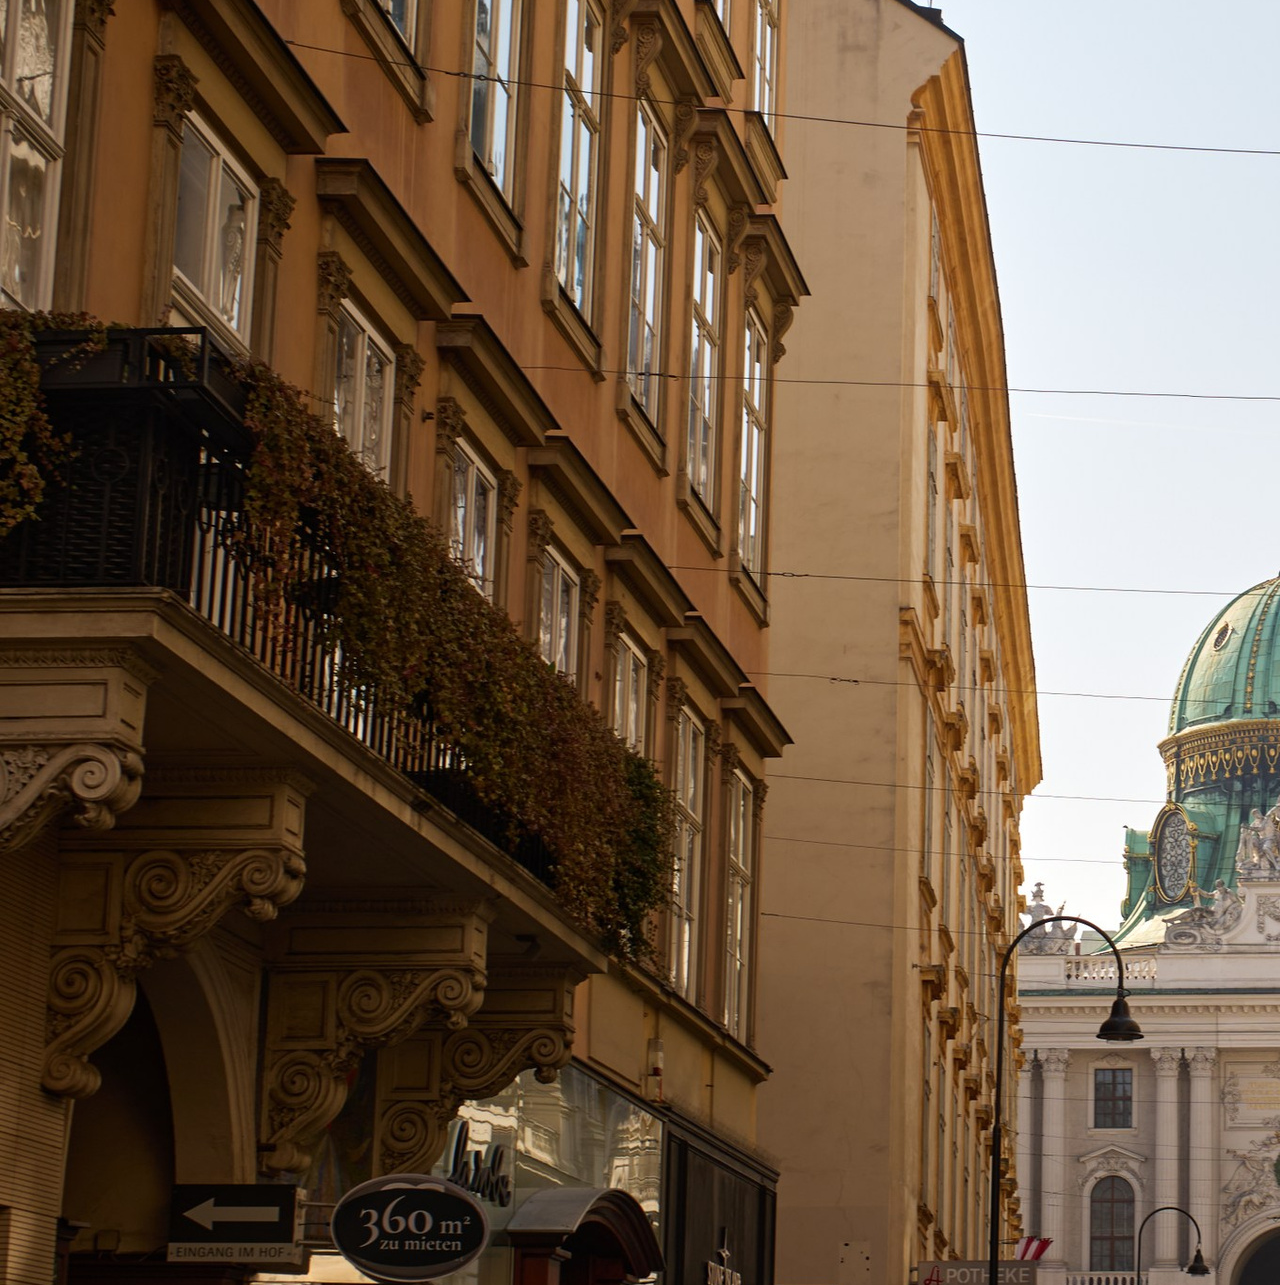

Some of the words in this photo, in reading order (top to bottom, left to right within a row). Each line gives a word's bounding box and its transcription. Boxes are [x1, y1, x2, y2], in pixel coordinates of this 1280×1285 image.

[358, 1195, 434, 1248] 360
[379, 1238, 399, 1251] zu
[403, 1235, 463, 1252] mieten
[175, 1246, 235, 1259] EINGANG
[238, 1246, 255, 1258] IM
[259, 1246, 285, 1258] HOF
